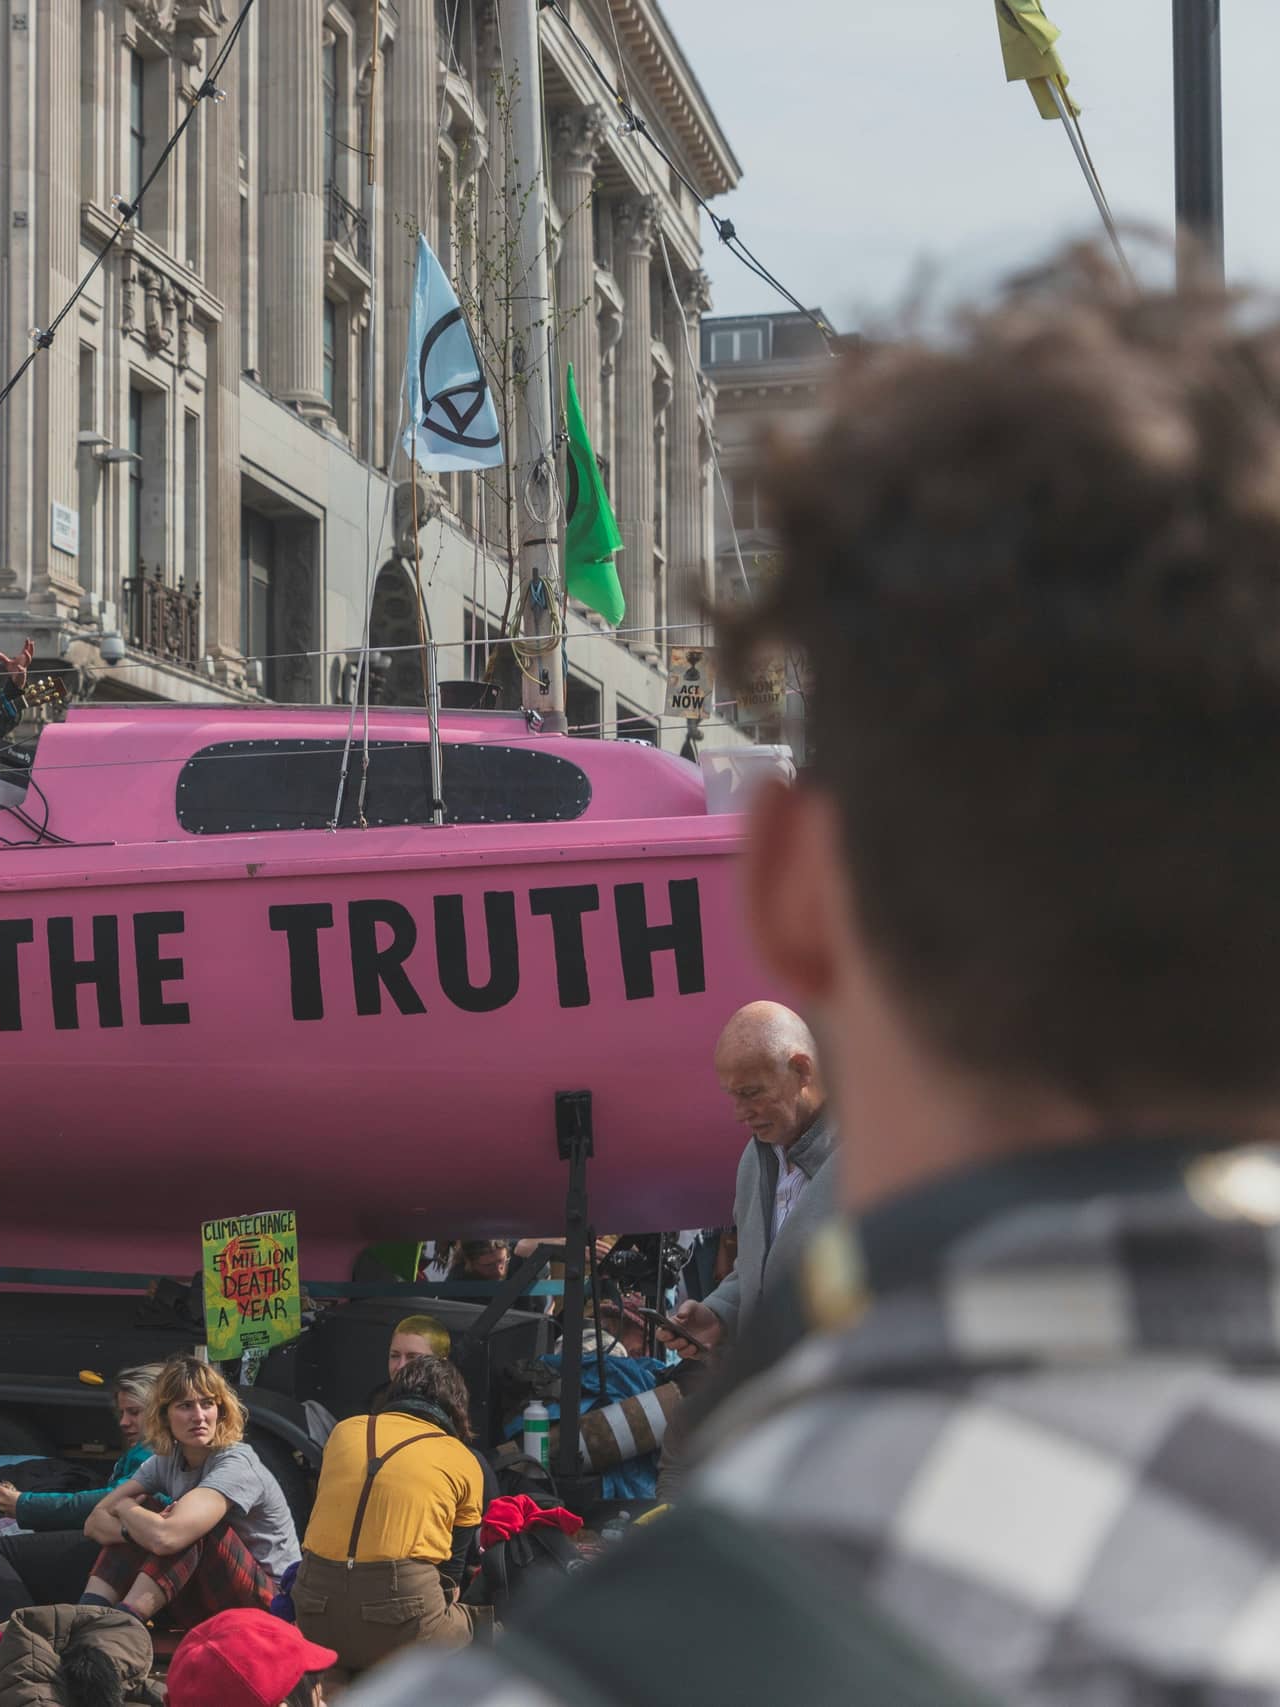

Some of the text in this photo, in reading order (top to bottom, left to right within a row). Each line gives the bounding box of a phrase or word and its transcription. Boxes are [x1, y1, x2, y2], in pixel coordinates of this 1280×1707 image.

[672, 695, 705, 709] NOW
[679, 685, 700, 695] ACT
[269, 878, 706, 1021] TRUTH
[212, 1246, 294, 1273] 5 MILLION
[223, 1268, 291, 1298] DEATHS
[218, 1297, 287, 1328] A YEAR
